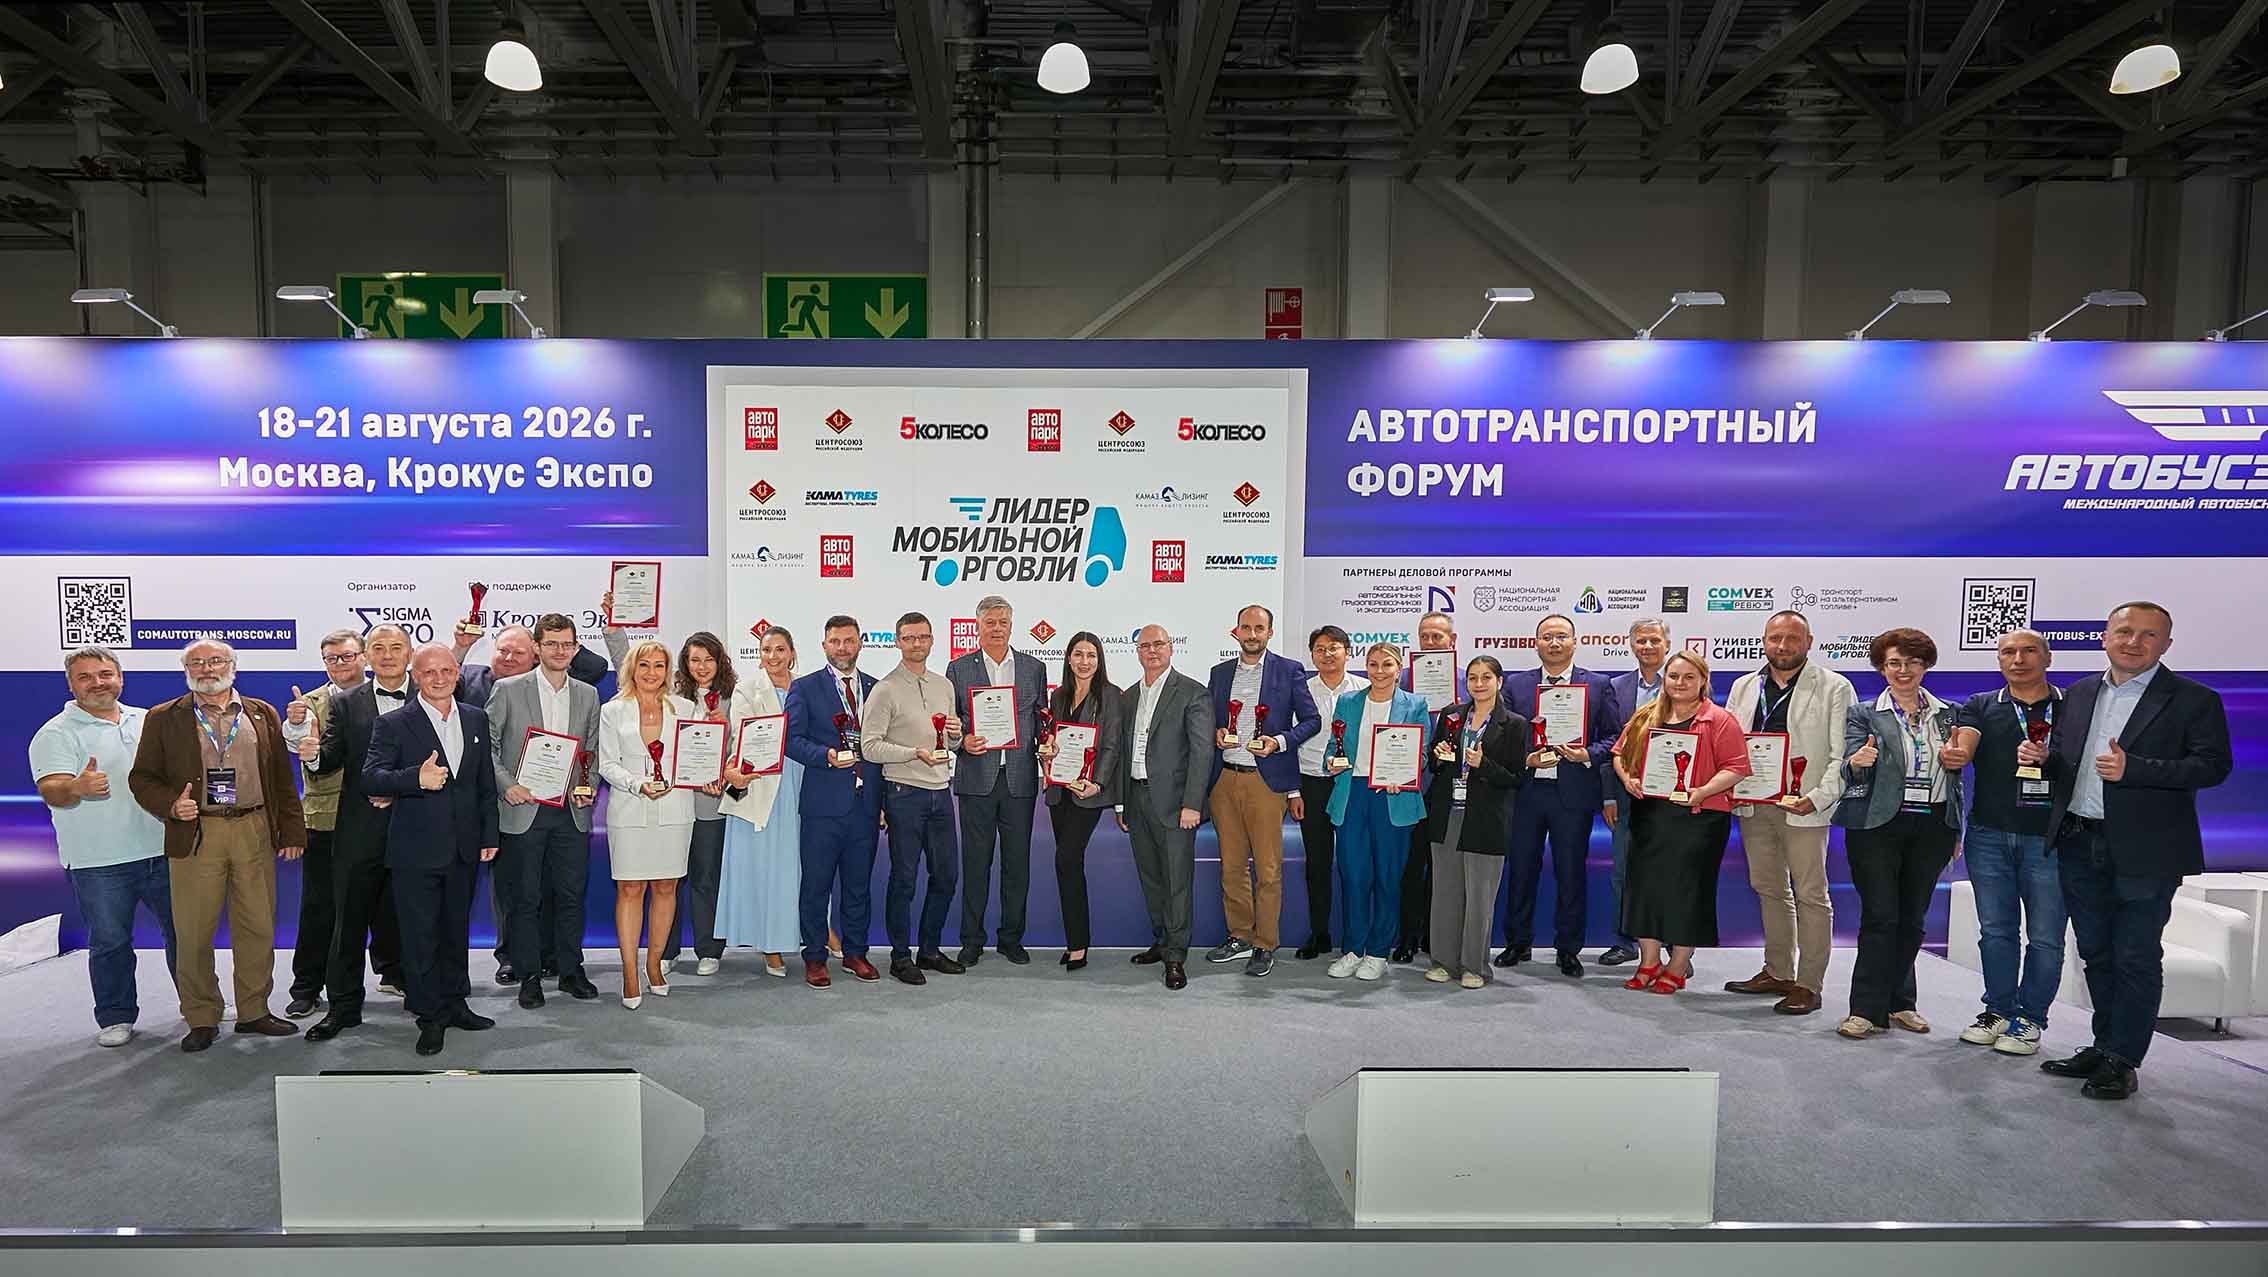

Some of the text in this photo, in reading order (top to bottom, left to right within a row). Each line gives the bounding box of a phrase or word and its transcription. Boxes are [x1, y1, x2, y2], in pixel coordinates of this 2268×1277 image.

[748, 411, 775, 425] авто
[1031, 412, 1058, 426] авто
[1347, 402, 1817, 443] АВТОТРАНСПОРТНЫЙ
[258, 406, 652, 444] 18-21 августа 2026 г.
[748, 425, 776, 443] парк
[1031, 426, 1059, 444] парк
[1098, 440, 1146, 448] ЦЕНТРОСОЮЗ
[218, 456, 653, 494] Москва, Крокус Экспо
[1347, 462, 1504, 497] ФОРУМ
[844, 491, 878, 500] TYRES
[2063, 497, 2196, 510] МЕЖДУНАРОДНЫЙ
[739, 508, 787, 516] ЦЕНТРОСОЮЗ
[987, 498, 1090, 524] ЛИДЕР
[1222, 511, 1270, 519] ЦЕНТРОСОЮЗ
[892, 525, 1084, 553] МОБИЛЬНОЙ
[823, 539, 850, 552] авто
[1155, 544, 1182, 557] авто
[823, 552, 851, 570] парк
[1244, 555, 1278, 565] TYRES
[1155, 557, 1183, 575] парк
[1343, 567, 1512, 578] ПАРТНЕРЫ ДЕЛОВОЙ ПРОГРАММЫ
[347, 582, 416, 592] Организатор
[493, 583, 552, 592] поддержке
[1708, 588, 1774, 598] COMVEX
[383, 607, 432, 620] SIGMA
[137, 629, 291, 640] COMAUTOTRANS.MOSCOW.RU
[1348, 632, 1410, 643] OMVEX
[1580, 634, 1629, 645] ancor
[1848, 635, 1875, 643] ЛИДЕ
[2041, 631, 2103, 640] UTOBUS-EX
[1474, 637, 1536, 648] ГРУЗОВО
[1713, 638, 1762, 646] УНИВЕР
[1819, 643, 1872, 651] МОБИЛЬНО
[1603, 648, 1629, 657] Drive
[1712, 647, 1765, 659] СИНЕР
[1827, 651, 1870, 659] ТОРГОВЛ
